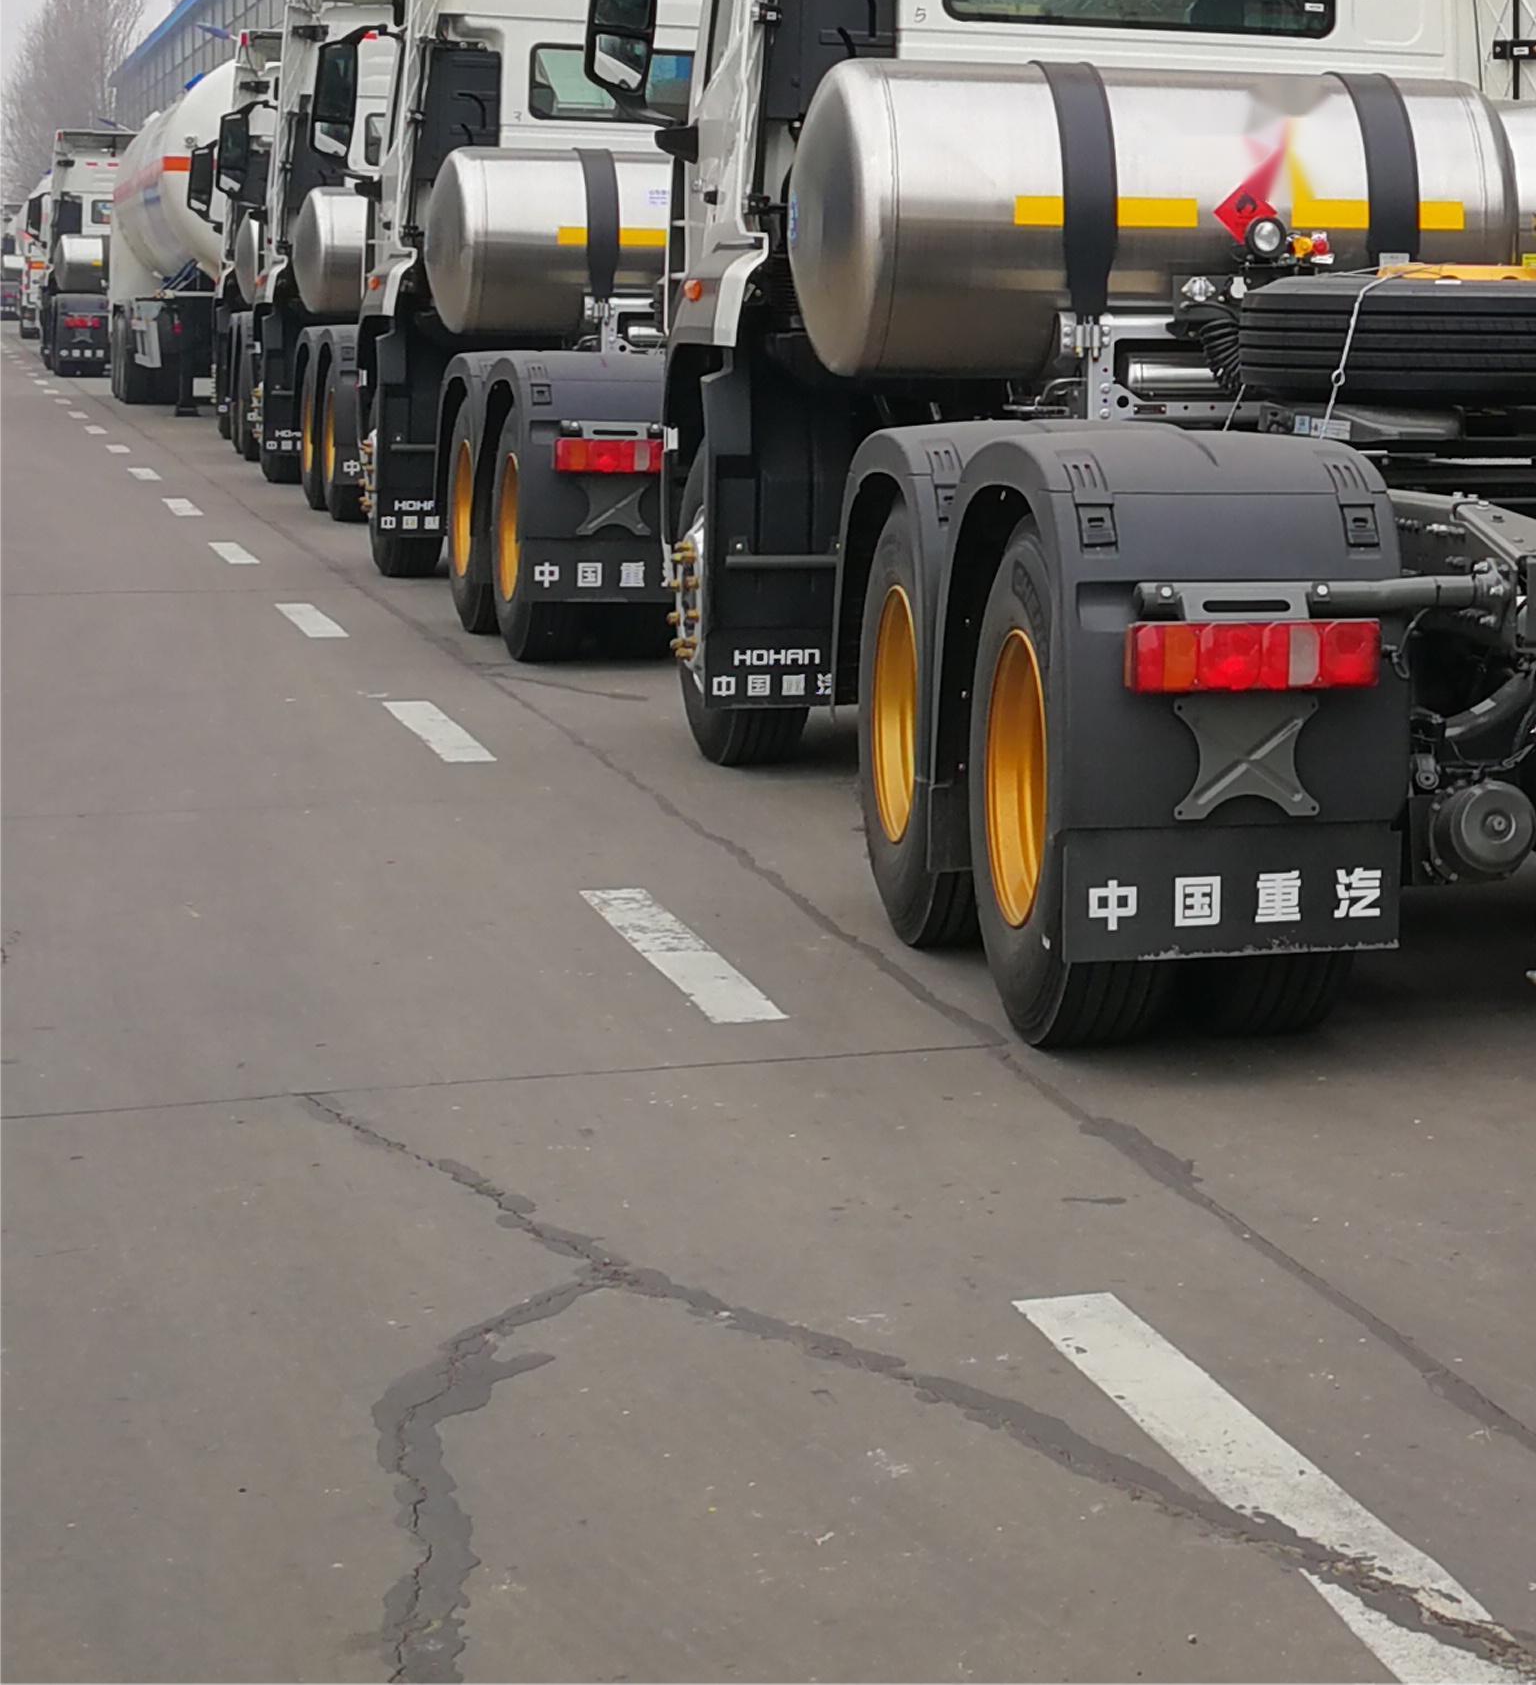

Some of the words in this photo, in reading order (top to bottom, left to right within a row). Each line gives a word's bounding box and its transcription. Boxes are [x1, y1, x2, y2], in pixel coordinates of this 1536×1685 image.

[734, 648, 820, 666] HOHAN
[1088, 866, 1383, 930] 中国重汽
